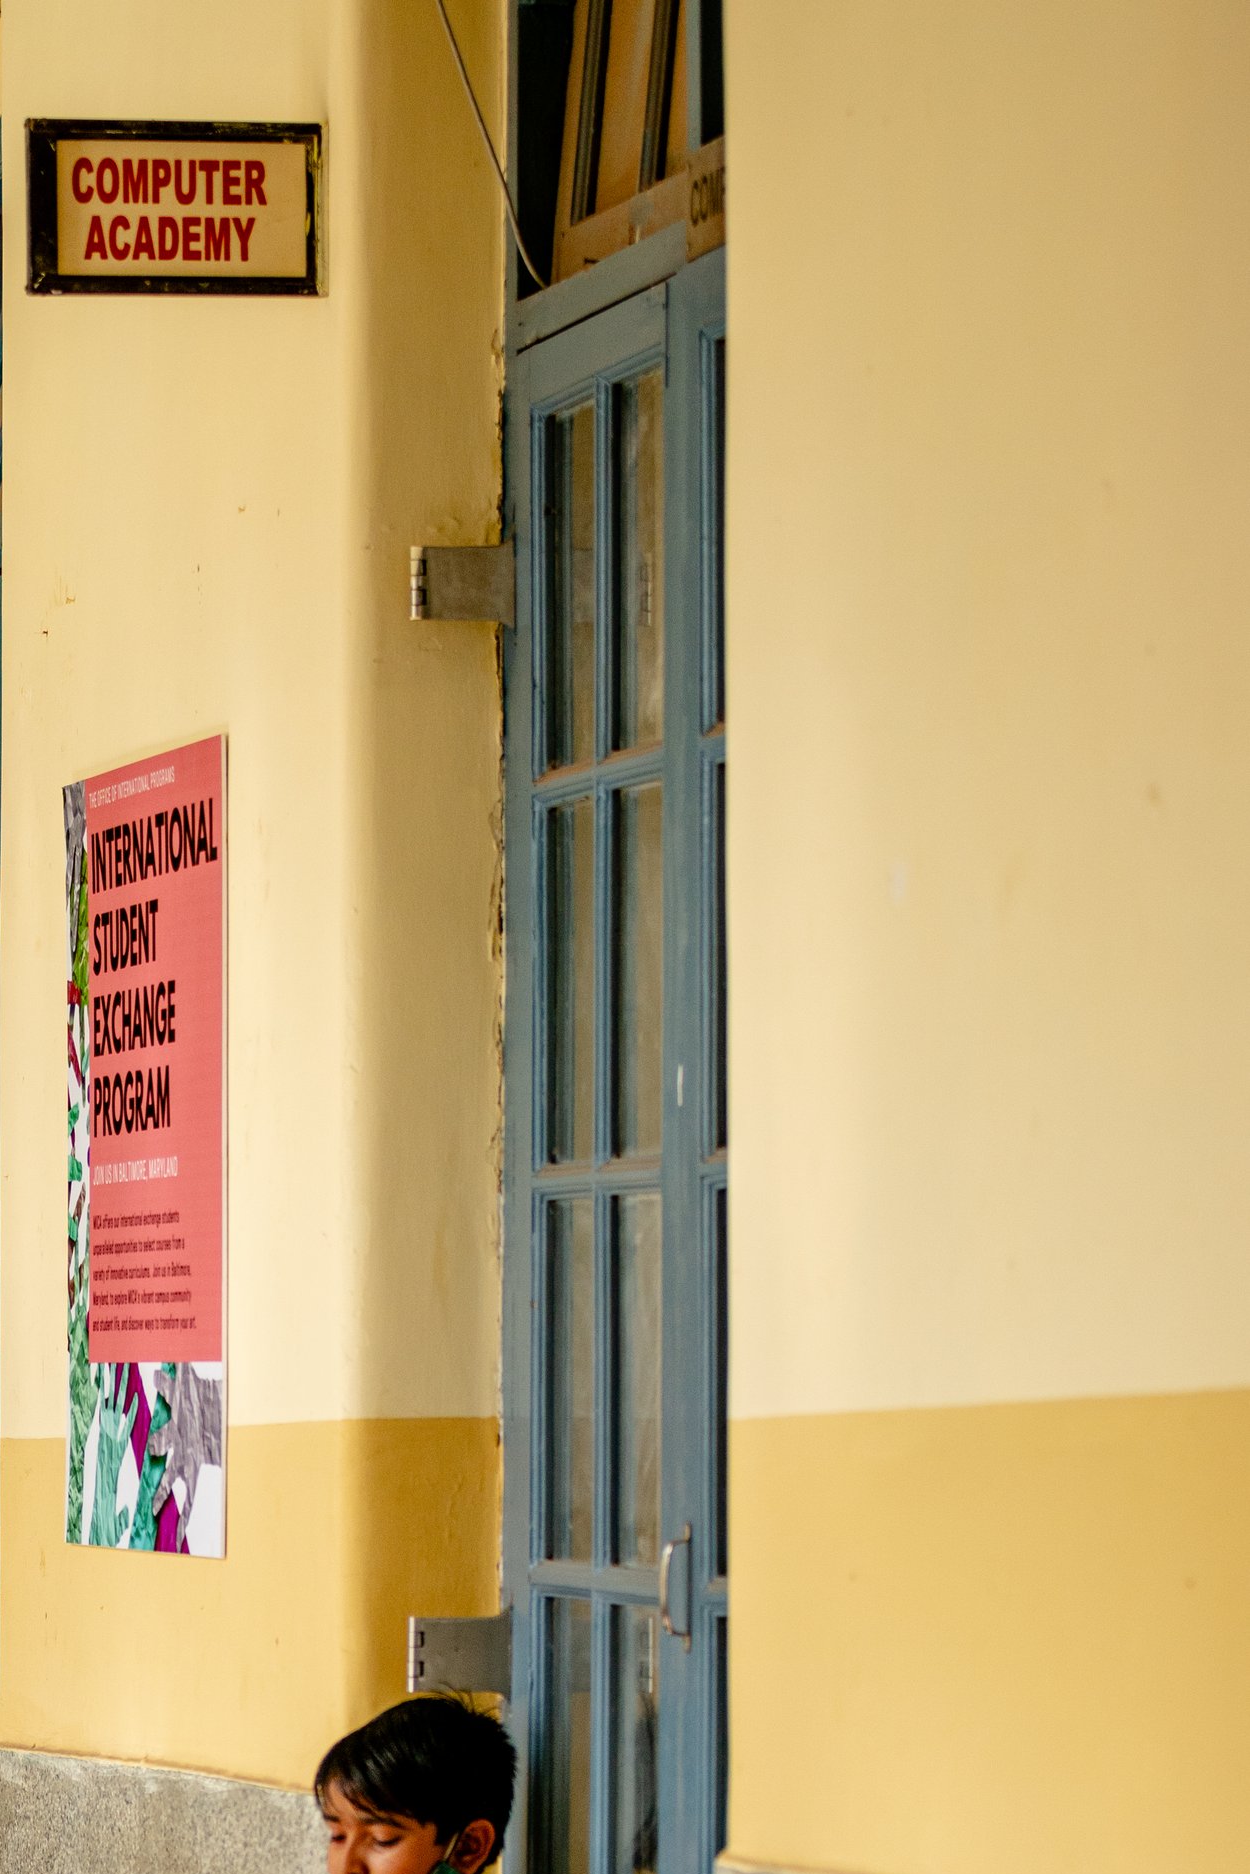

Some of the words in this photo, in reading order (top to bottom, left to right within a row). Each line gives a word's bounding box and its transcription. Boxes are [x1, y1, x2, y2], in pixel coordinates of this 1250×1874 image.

[72, 157, 268, 206] COMPUTER
[84, 216, 256, 262] ACADEMY
[118, 775, 150, 798] INTERNATIONAL
[150, 766, 174, 788] PROGRAMS
[91, 798, 218, 894] INTERNATIONAL
[93, 899, 158, 976] STUDENT
[94, 980, 176, 1057] EXCHANGE
[94, 1065, 170, 1138] PROGRAM
[93, 1164, 104, 1186] JOIN
[106, 1163, 112, 1184] US
[113, 1162, 118, 1183] IN
[149, 1156, 178, 1179] MARYLAND
